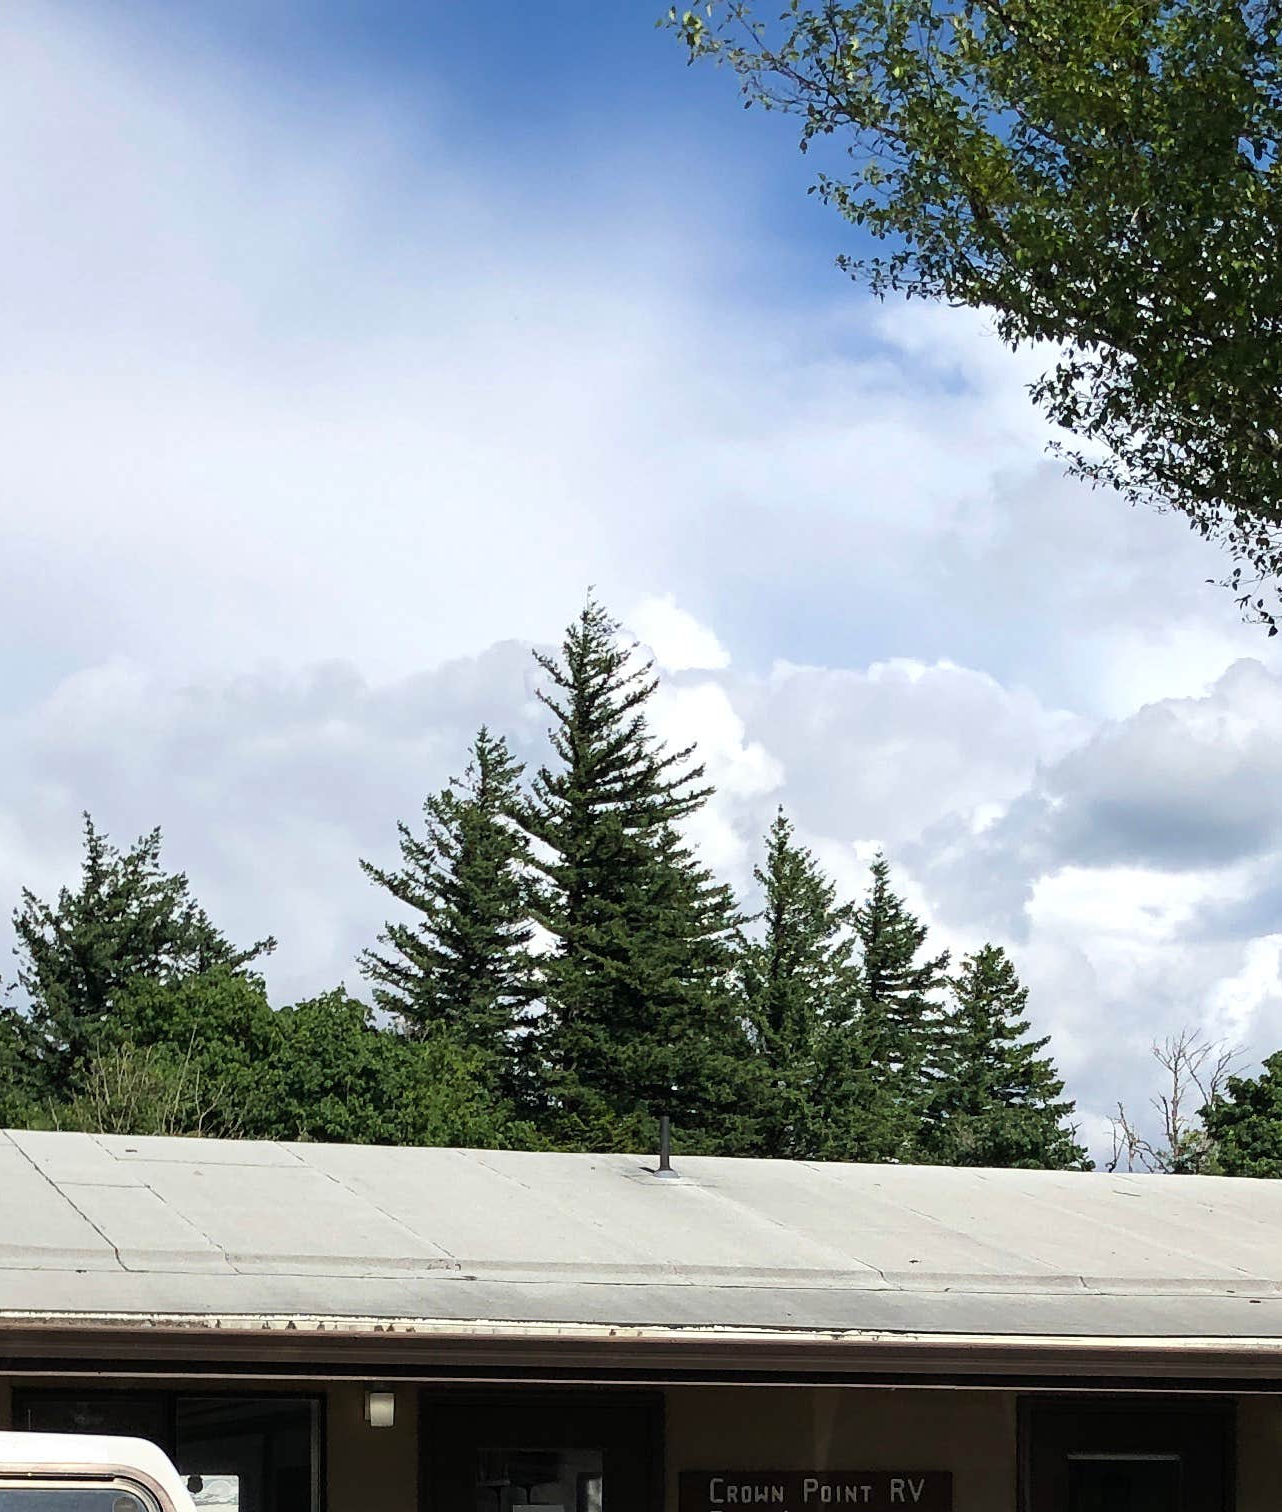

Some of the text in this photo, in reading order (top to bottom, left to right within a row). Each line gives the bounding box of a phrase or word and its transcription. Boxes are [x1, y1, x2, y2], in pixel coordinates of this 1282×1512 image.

[709, 1477, 926, 1504] CROWN POINT RV
